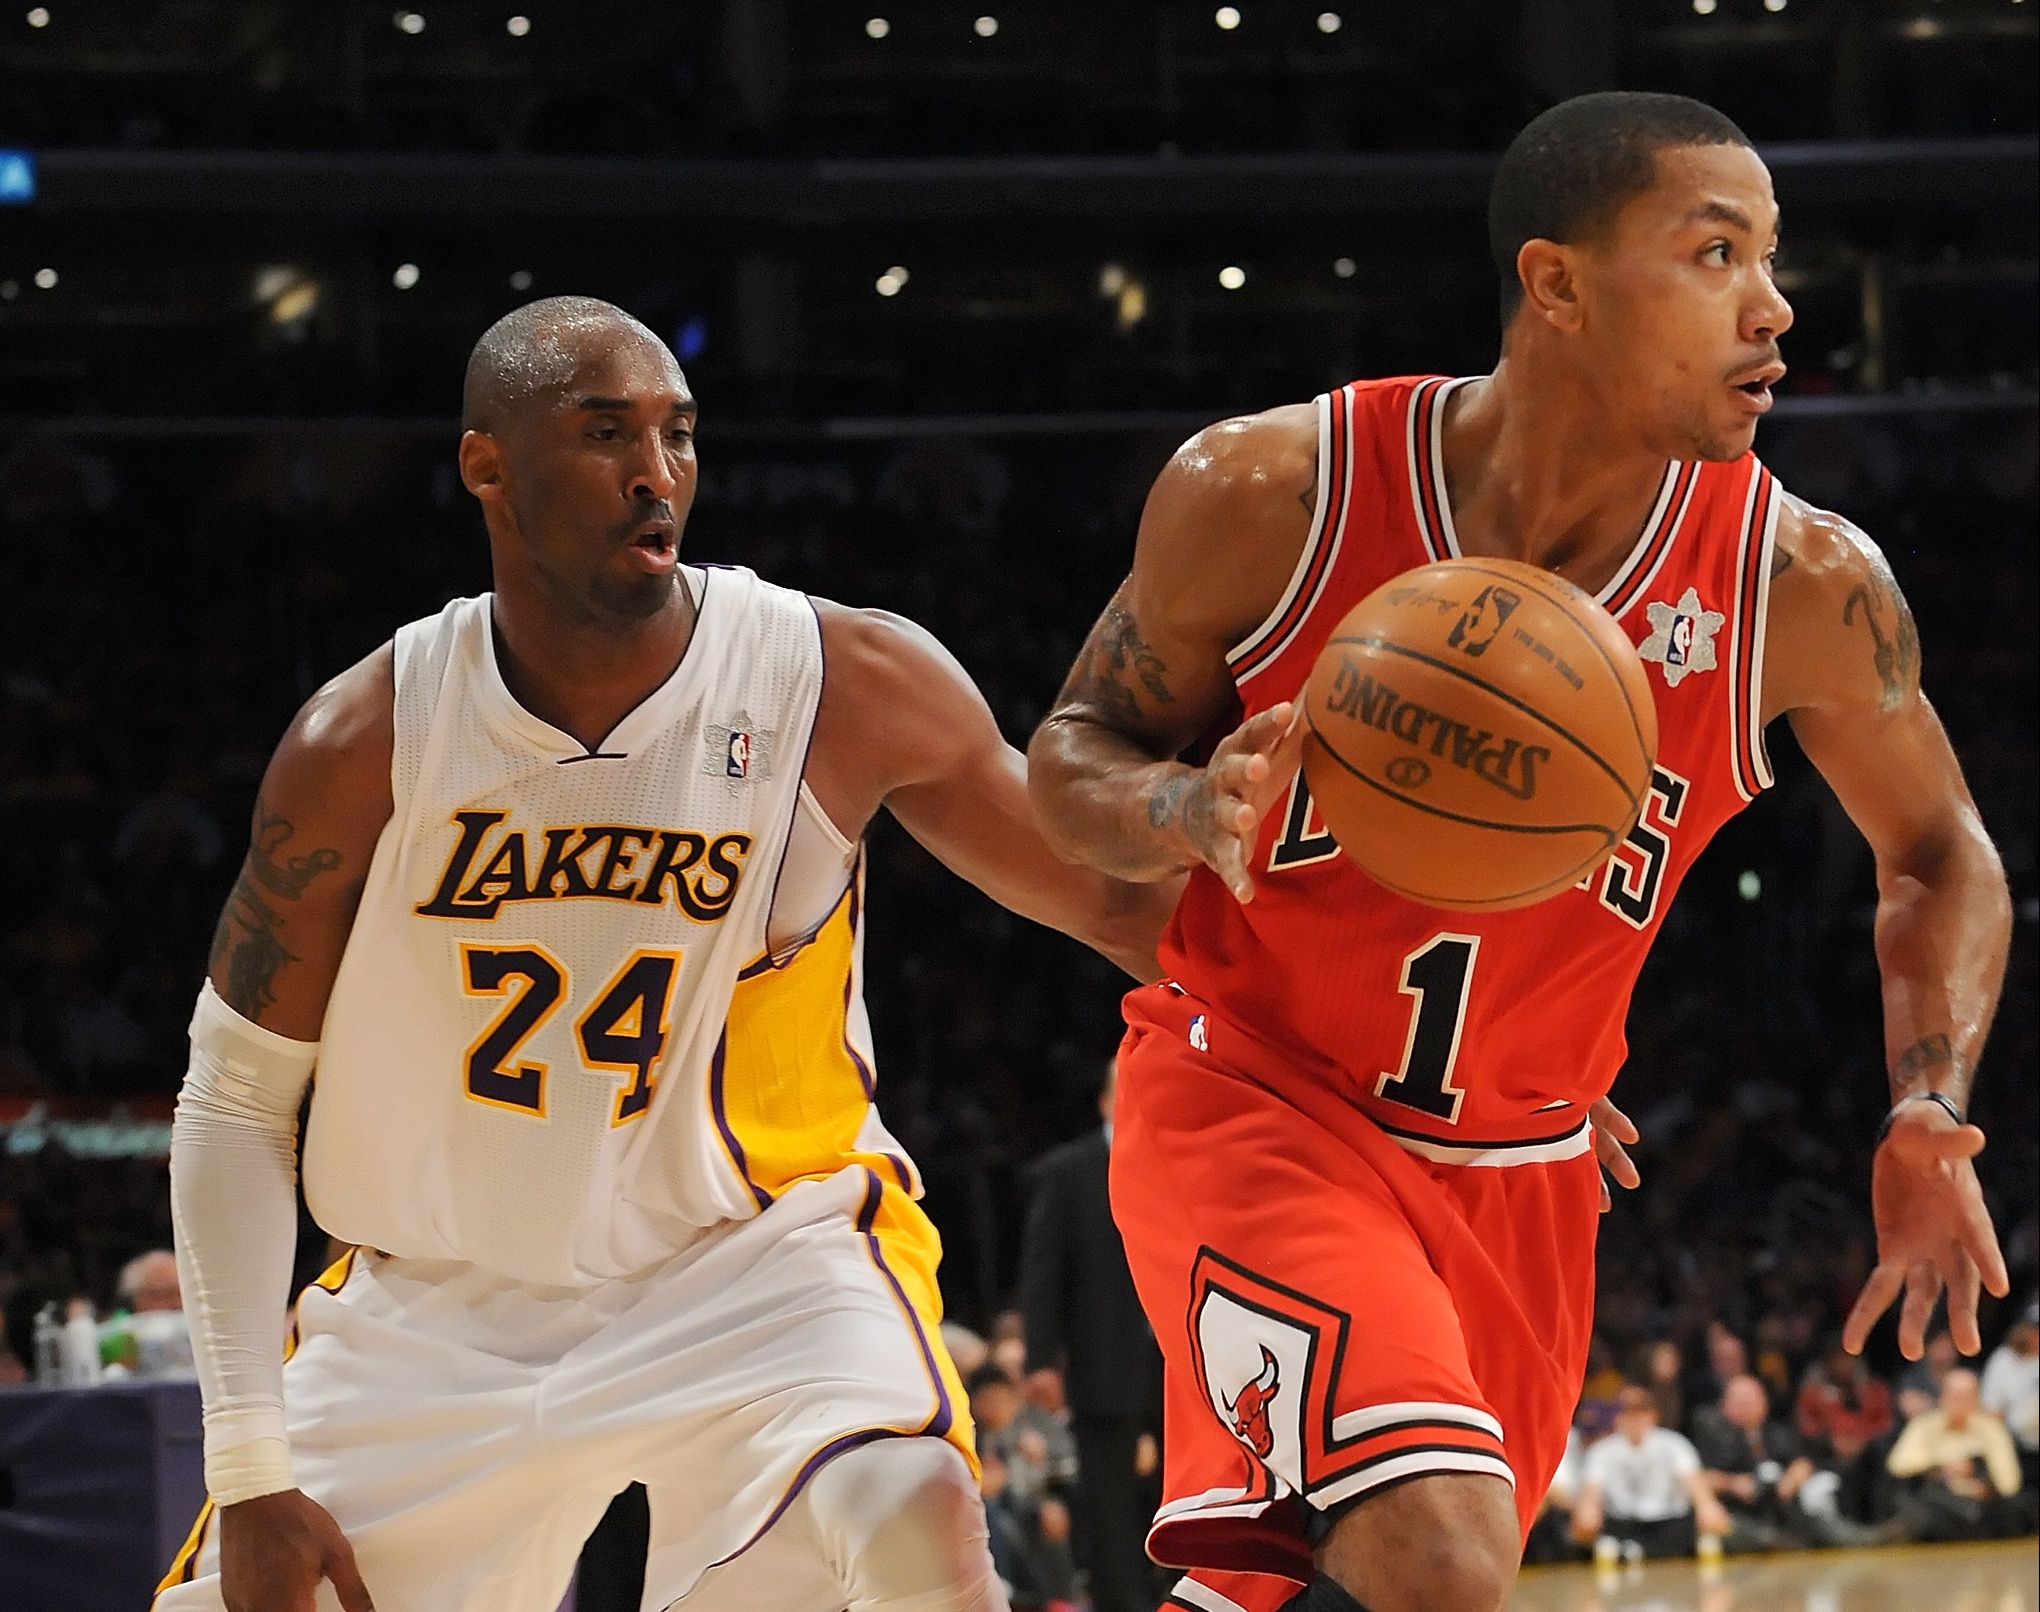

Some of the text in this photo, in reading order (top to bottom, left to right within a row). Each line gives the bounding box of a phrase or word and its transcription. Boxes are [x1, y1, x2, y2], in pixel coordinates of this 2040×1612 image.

[1326, 654, 1552, 801] SPALDING
[414, 809, 754, 924] LAKERS
[459, 942, 684, 1128] 24
[1374, 932, 1481, 1125] 1
